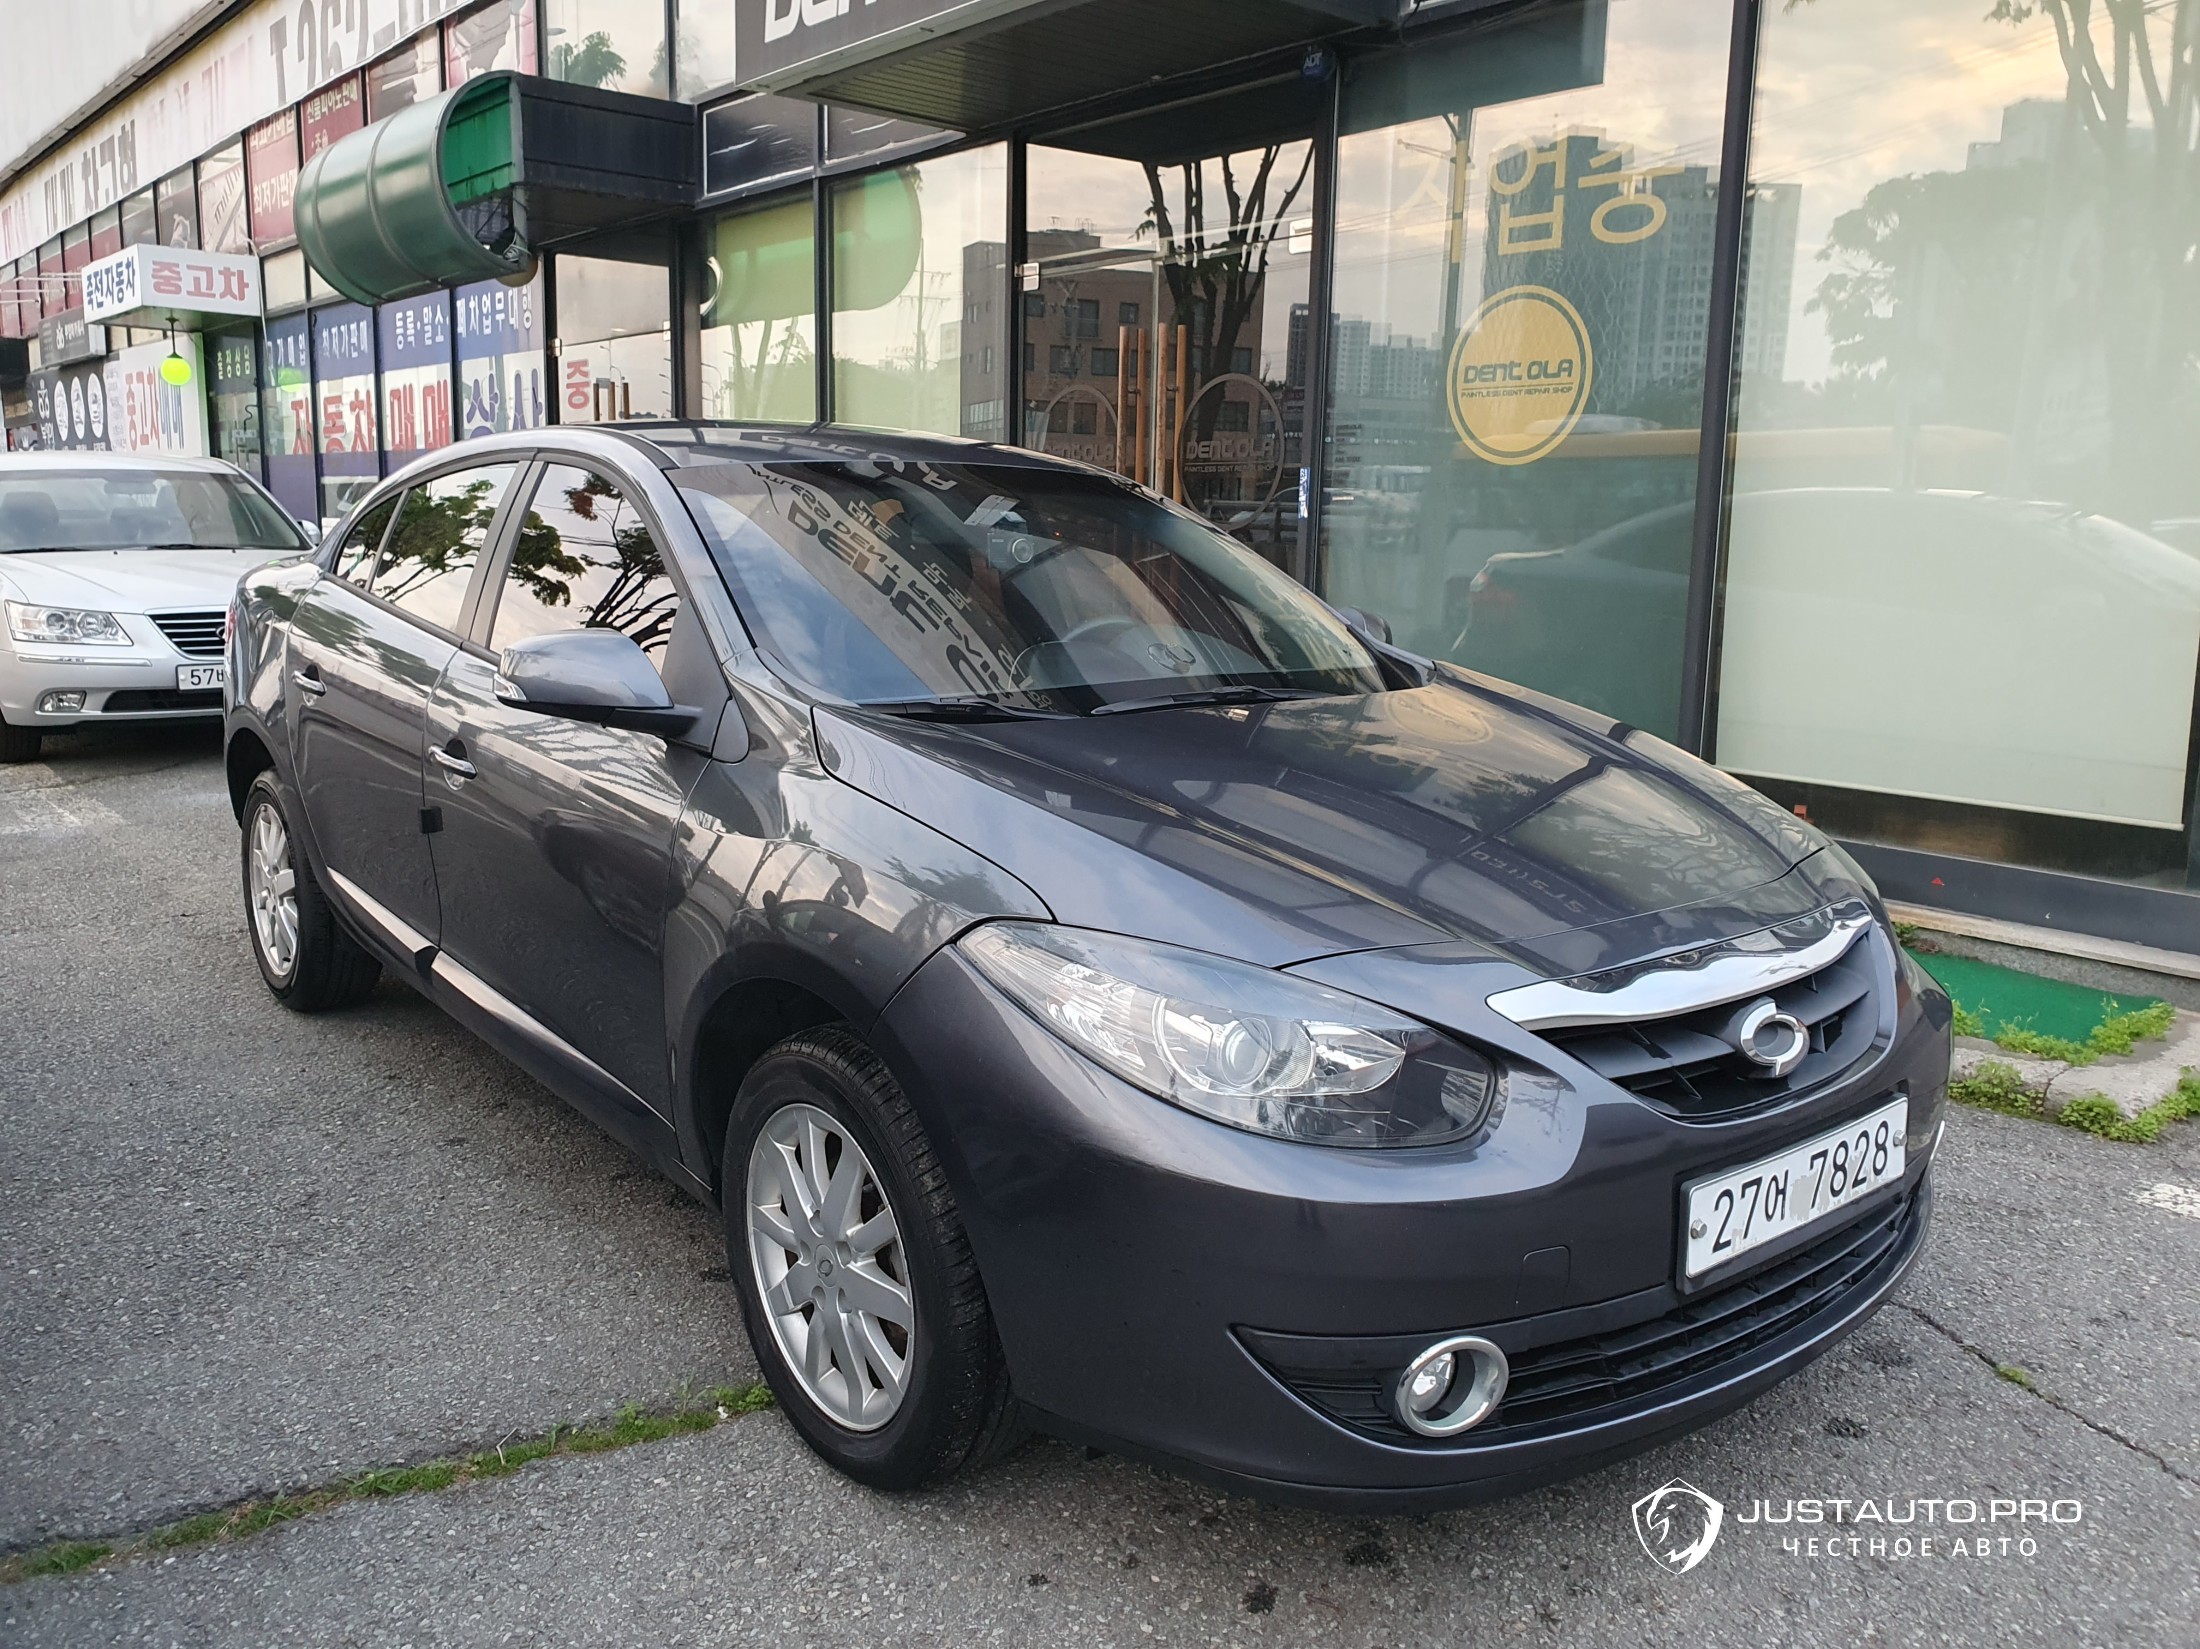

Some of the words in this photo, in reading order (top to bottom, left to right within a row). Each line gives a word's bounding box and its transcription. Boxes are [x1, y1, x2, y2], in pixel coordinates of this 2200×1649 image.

[1303, 52, 1322, 69] ADT
[86, 255, 136, 311] 죽전자동차
[151, 259, 249, 301] 중고차
[1526, 358, 1574, 381] OLA
[1461, 390, 1501, 399] PAINTLESS
[1502, 388, 1523, 397] DENT
[1524, 387, 1550, 396] REPAIR
[1551, 386, 1573, 394] SHOP
[1711, 1168, 1789, 1255] 27어
[1809, 1120, 1890, 1210] 7828
